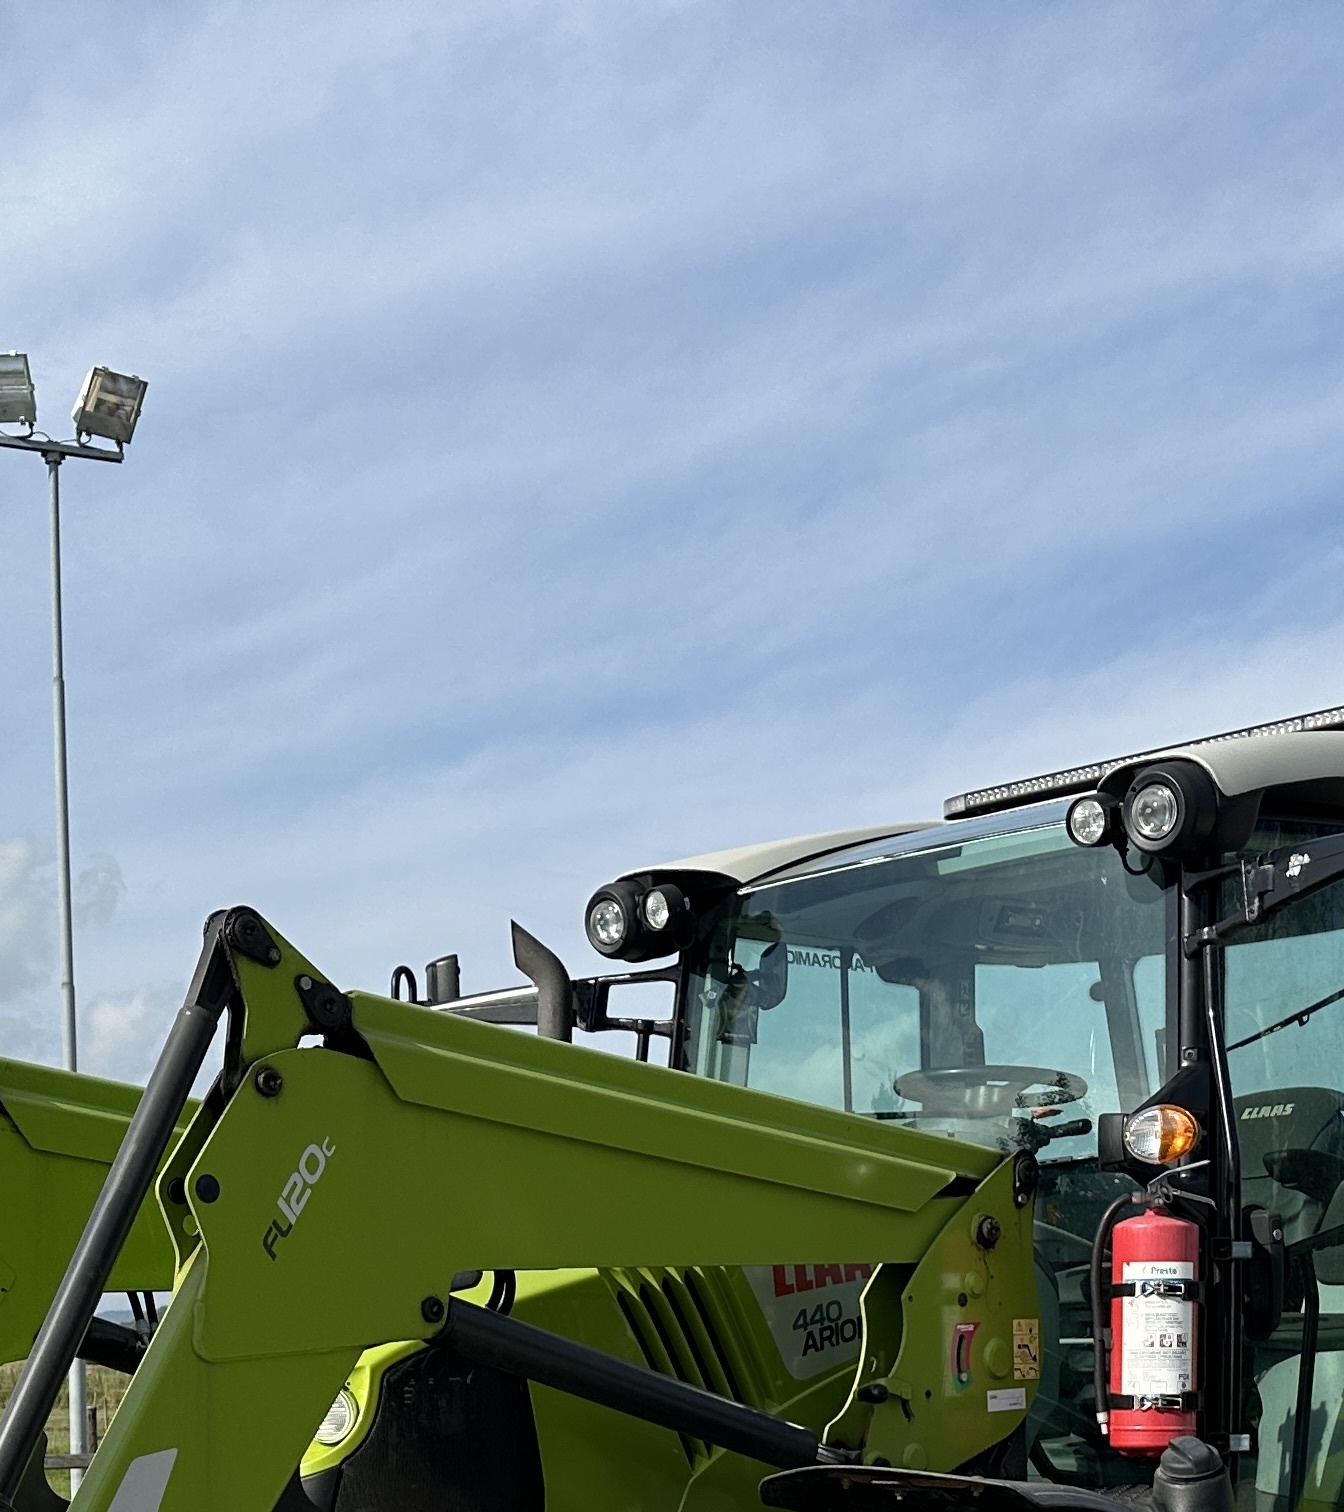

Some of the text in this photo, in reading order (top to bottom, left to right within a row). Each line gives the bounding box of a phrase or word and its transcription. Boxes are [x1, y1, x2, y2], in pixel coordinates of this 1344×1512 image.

[1241, 1103, 1295, 1119] CLAAS
[773, 1264, 871, 1297] CLA
[792, 1299, 843, 1331] 440
[802, 1316, 862, 1357] ARIO
